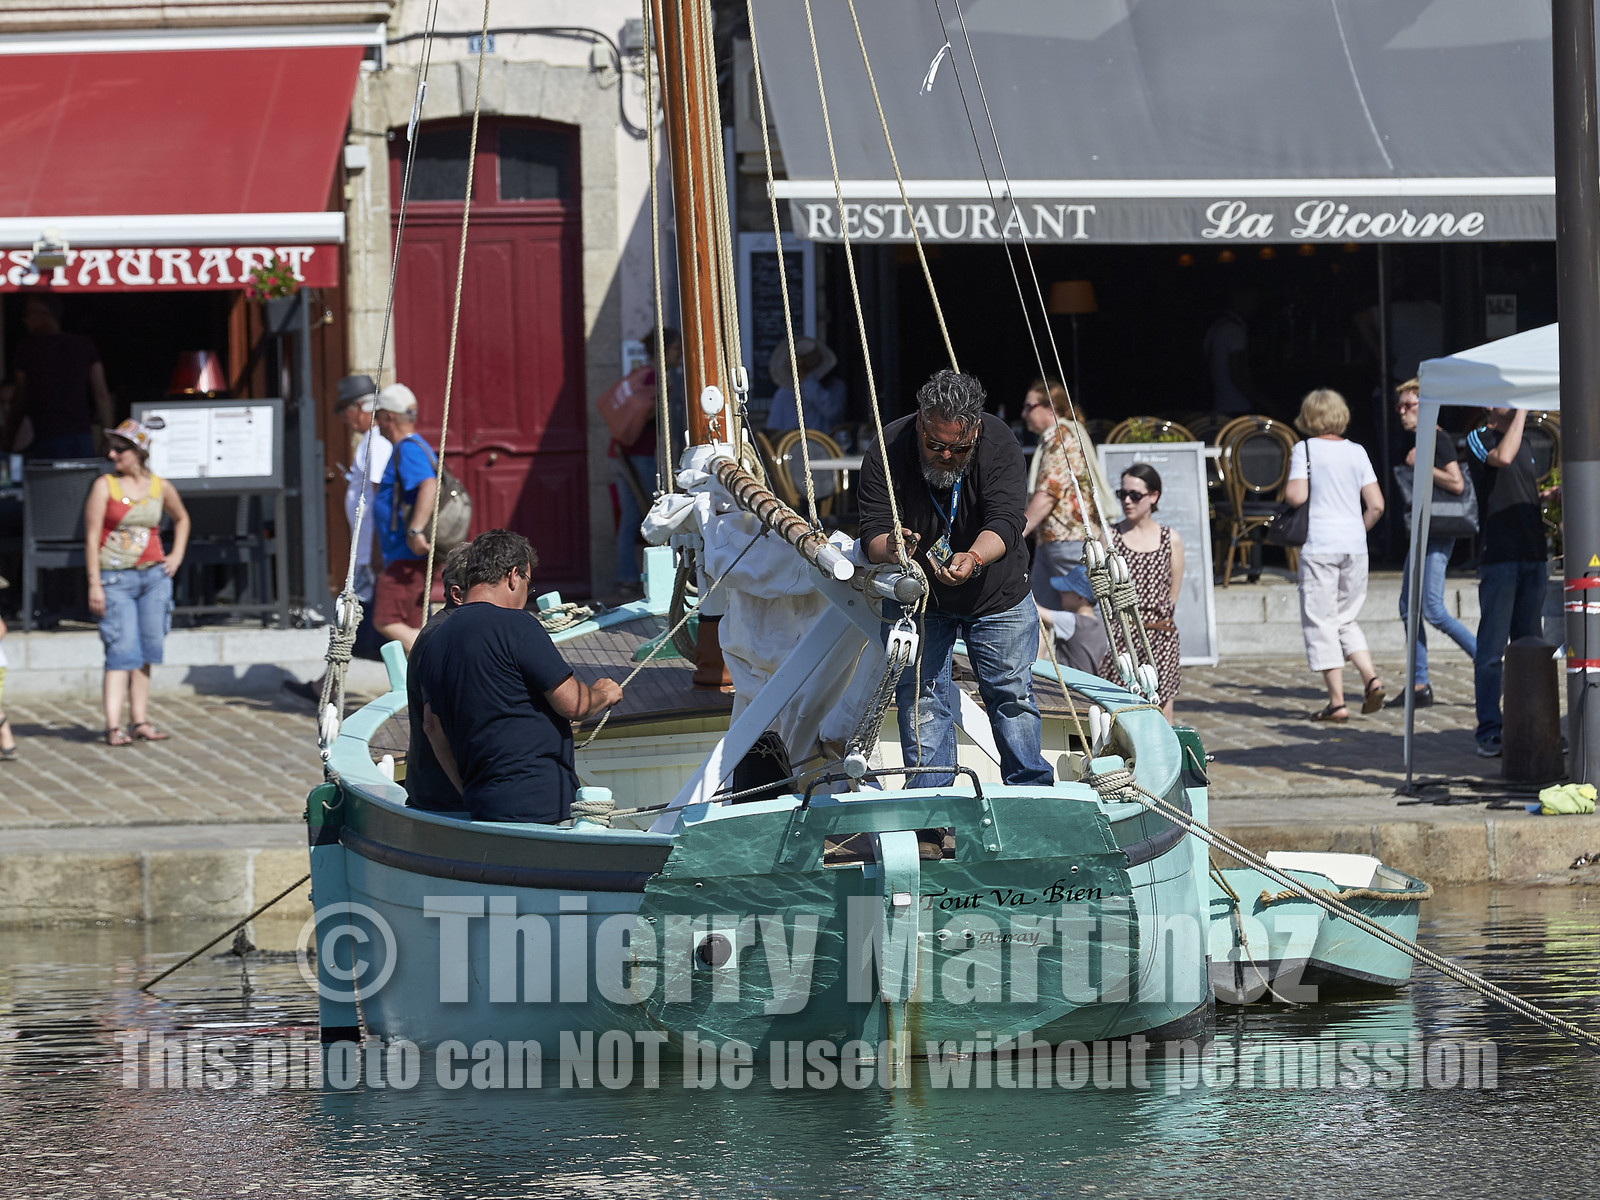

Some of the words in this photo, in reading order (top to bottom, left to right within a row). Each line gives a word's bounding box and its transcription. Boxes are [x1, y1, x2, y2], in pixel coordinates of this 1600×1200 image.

[805, 204, 1097, 240] RESTAURANT
[1201, 200, 1275, 239] La
[1290, 200, 1486, 238] Licorne
[919, 888, 984, 912] Tout
[990, 889, 1037, 906] Va
[1042, 878, 1114, 904] Bien
[976, 930, 1049, 949] Auray
